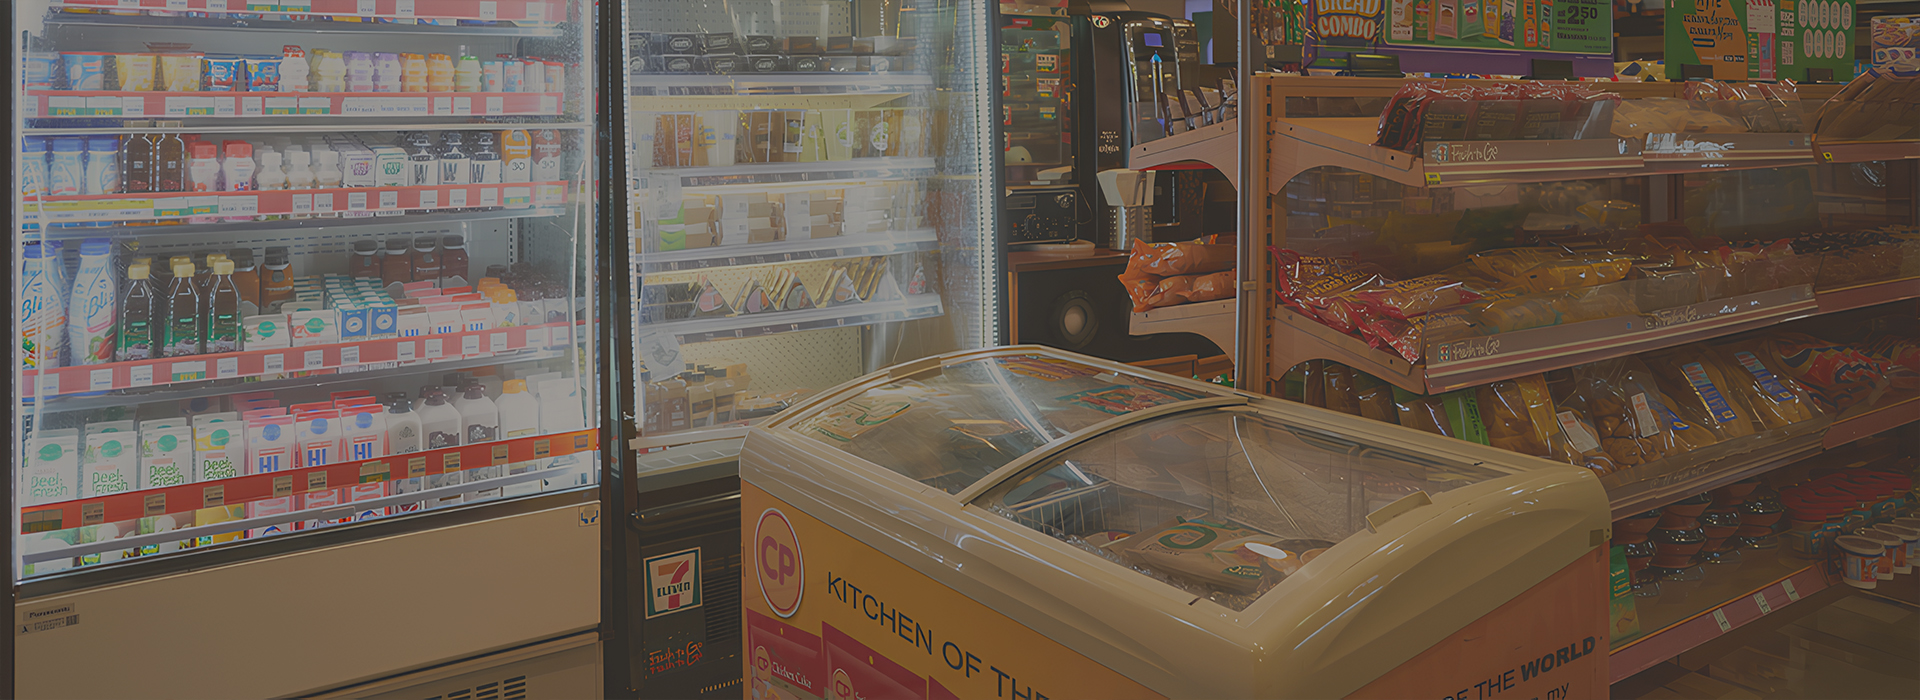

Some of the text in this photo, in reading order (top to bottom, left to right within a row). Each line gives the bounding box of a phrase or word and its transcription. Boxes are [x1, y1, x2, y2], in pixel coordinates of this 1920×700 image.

[1318, 15, 1377, 40] COMBO
[761, 535, 796, 586] CP
[828, 571, 1050, 700] KITCHEN OF TH
[1473, 669, 1515, 700] THE
[1521, 635, 1595, 682] WORLD
